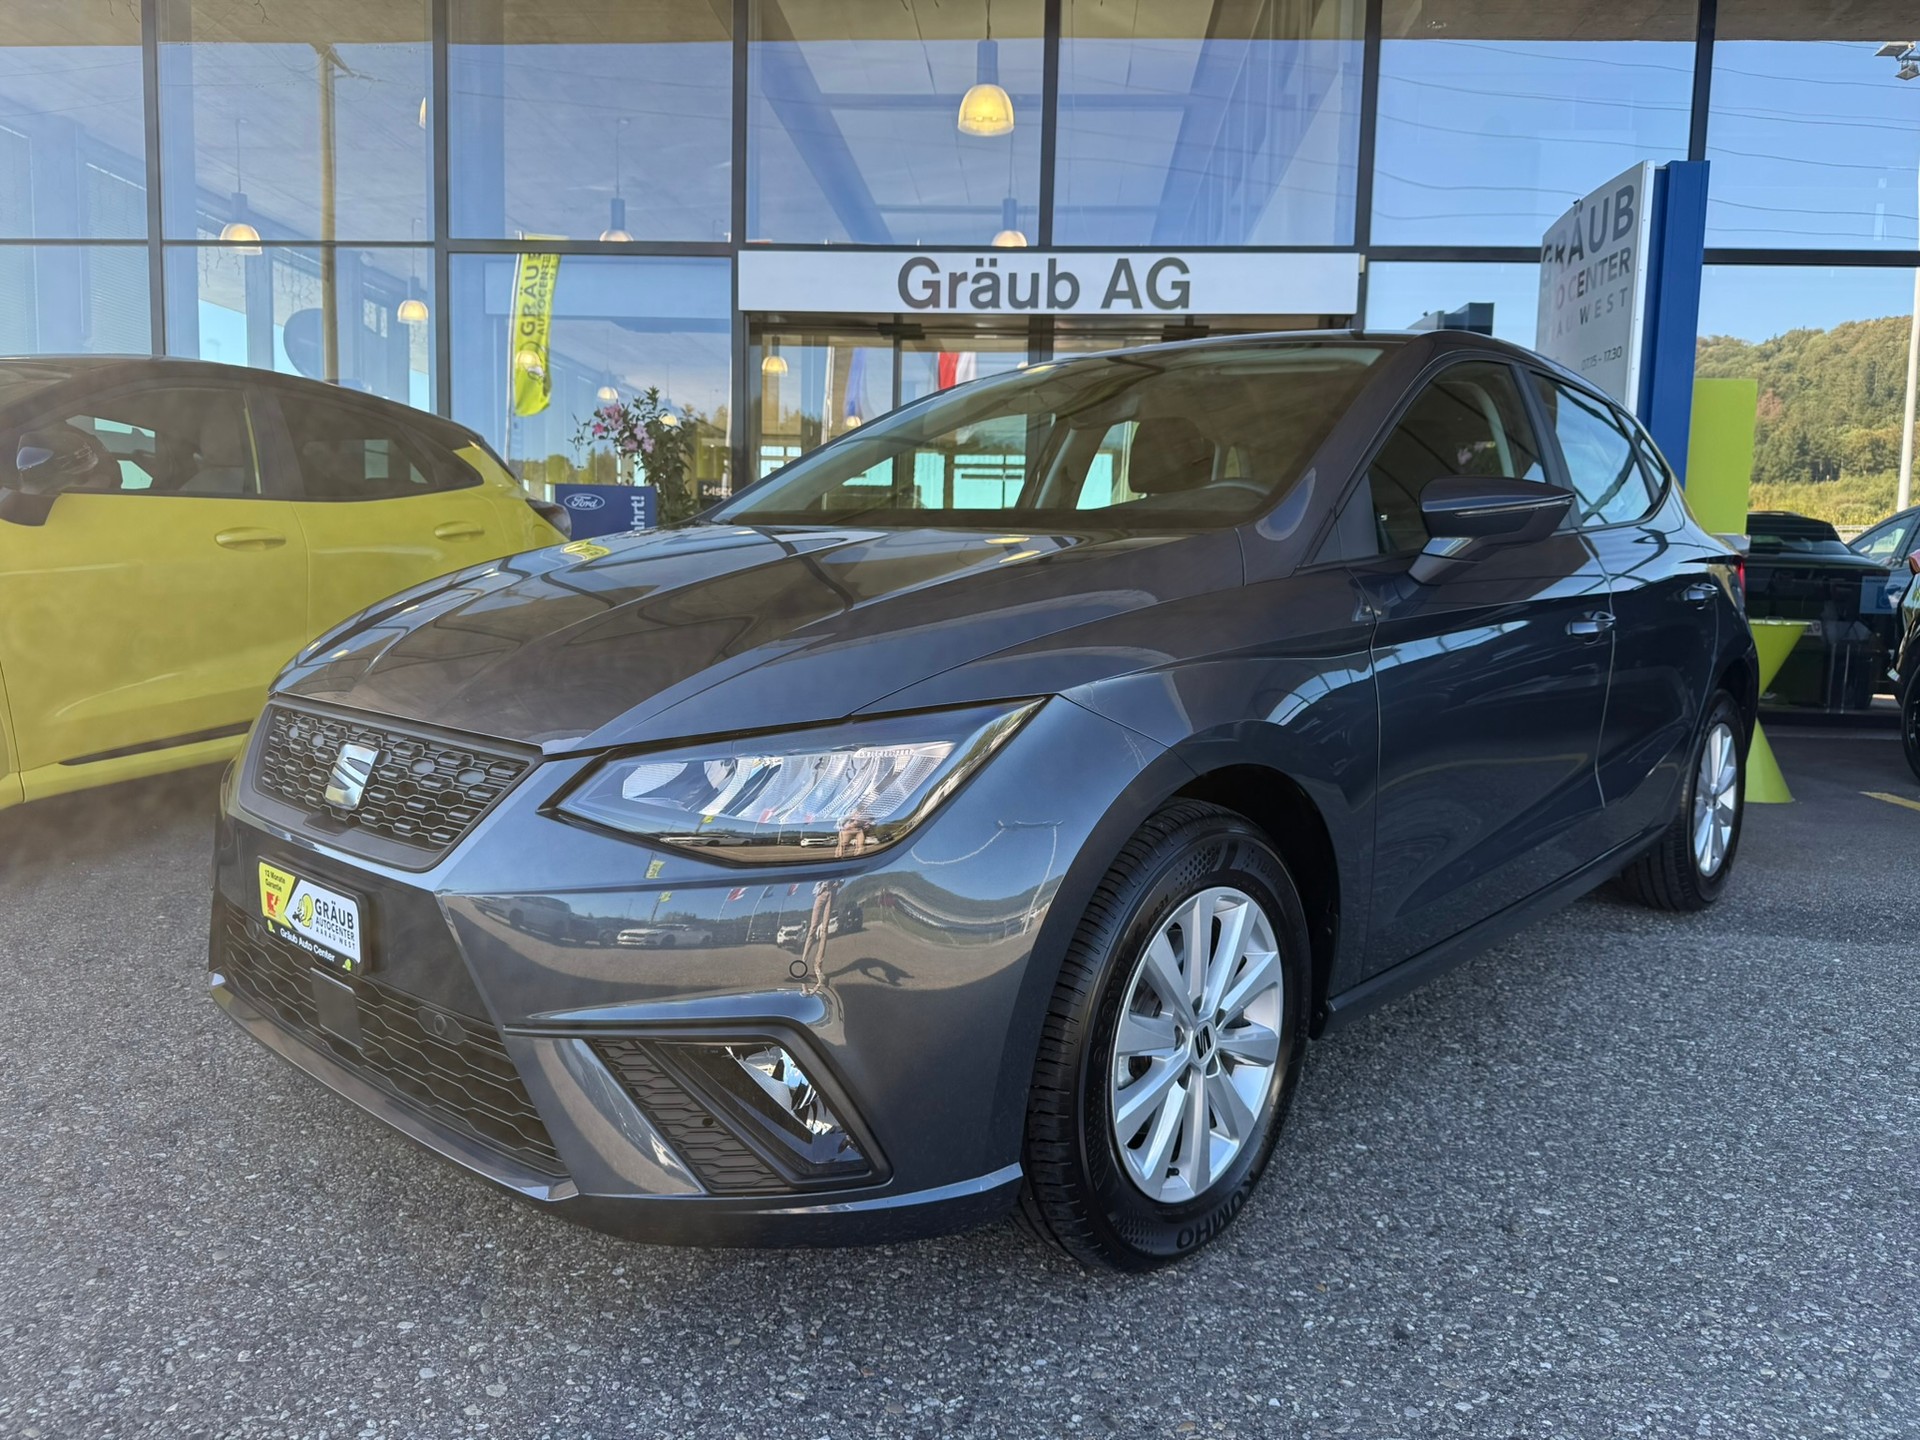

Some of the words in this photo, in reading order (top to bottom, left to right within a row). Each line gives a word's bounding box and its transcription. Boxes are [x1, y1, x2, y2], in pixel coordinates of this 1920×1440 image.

[897, 256, 1080, 310] Gräub
[1100, 256, 1191, 310] AG
[1579, 287, 1628, 325] WEST
[571, 495, 598, 508] Ford
[265, 878, 282, 892] Garantie
[314, 898, 355, 930] GRÄUB
[315, 917, 355, 942] AUTOCENTER
[280, 928, 298, 944] Gräub
[298, 937, 313, 952] Auto
[313, 944, 336, 962] Center
[315, 927, 337, 941] AARAU
[339, 938, 356, 950] WEST
[1176, 1170, 1256, 1250] KUMHO
